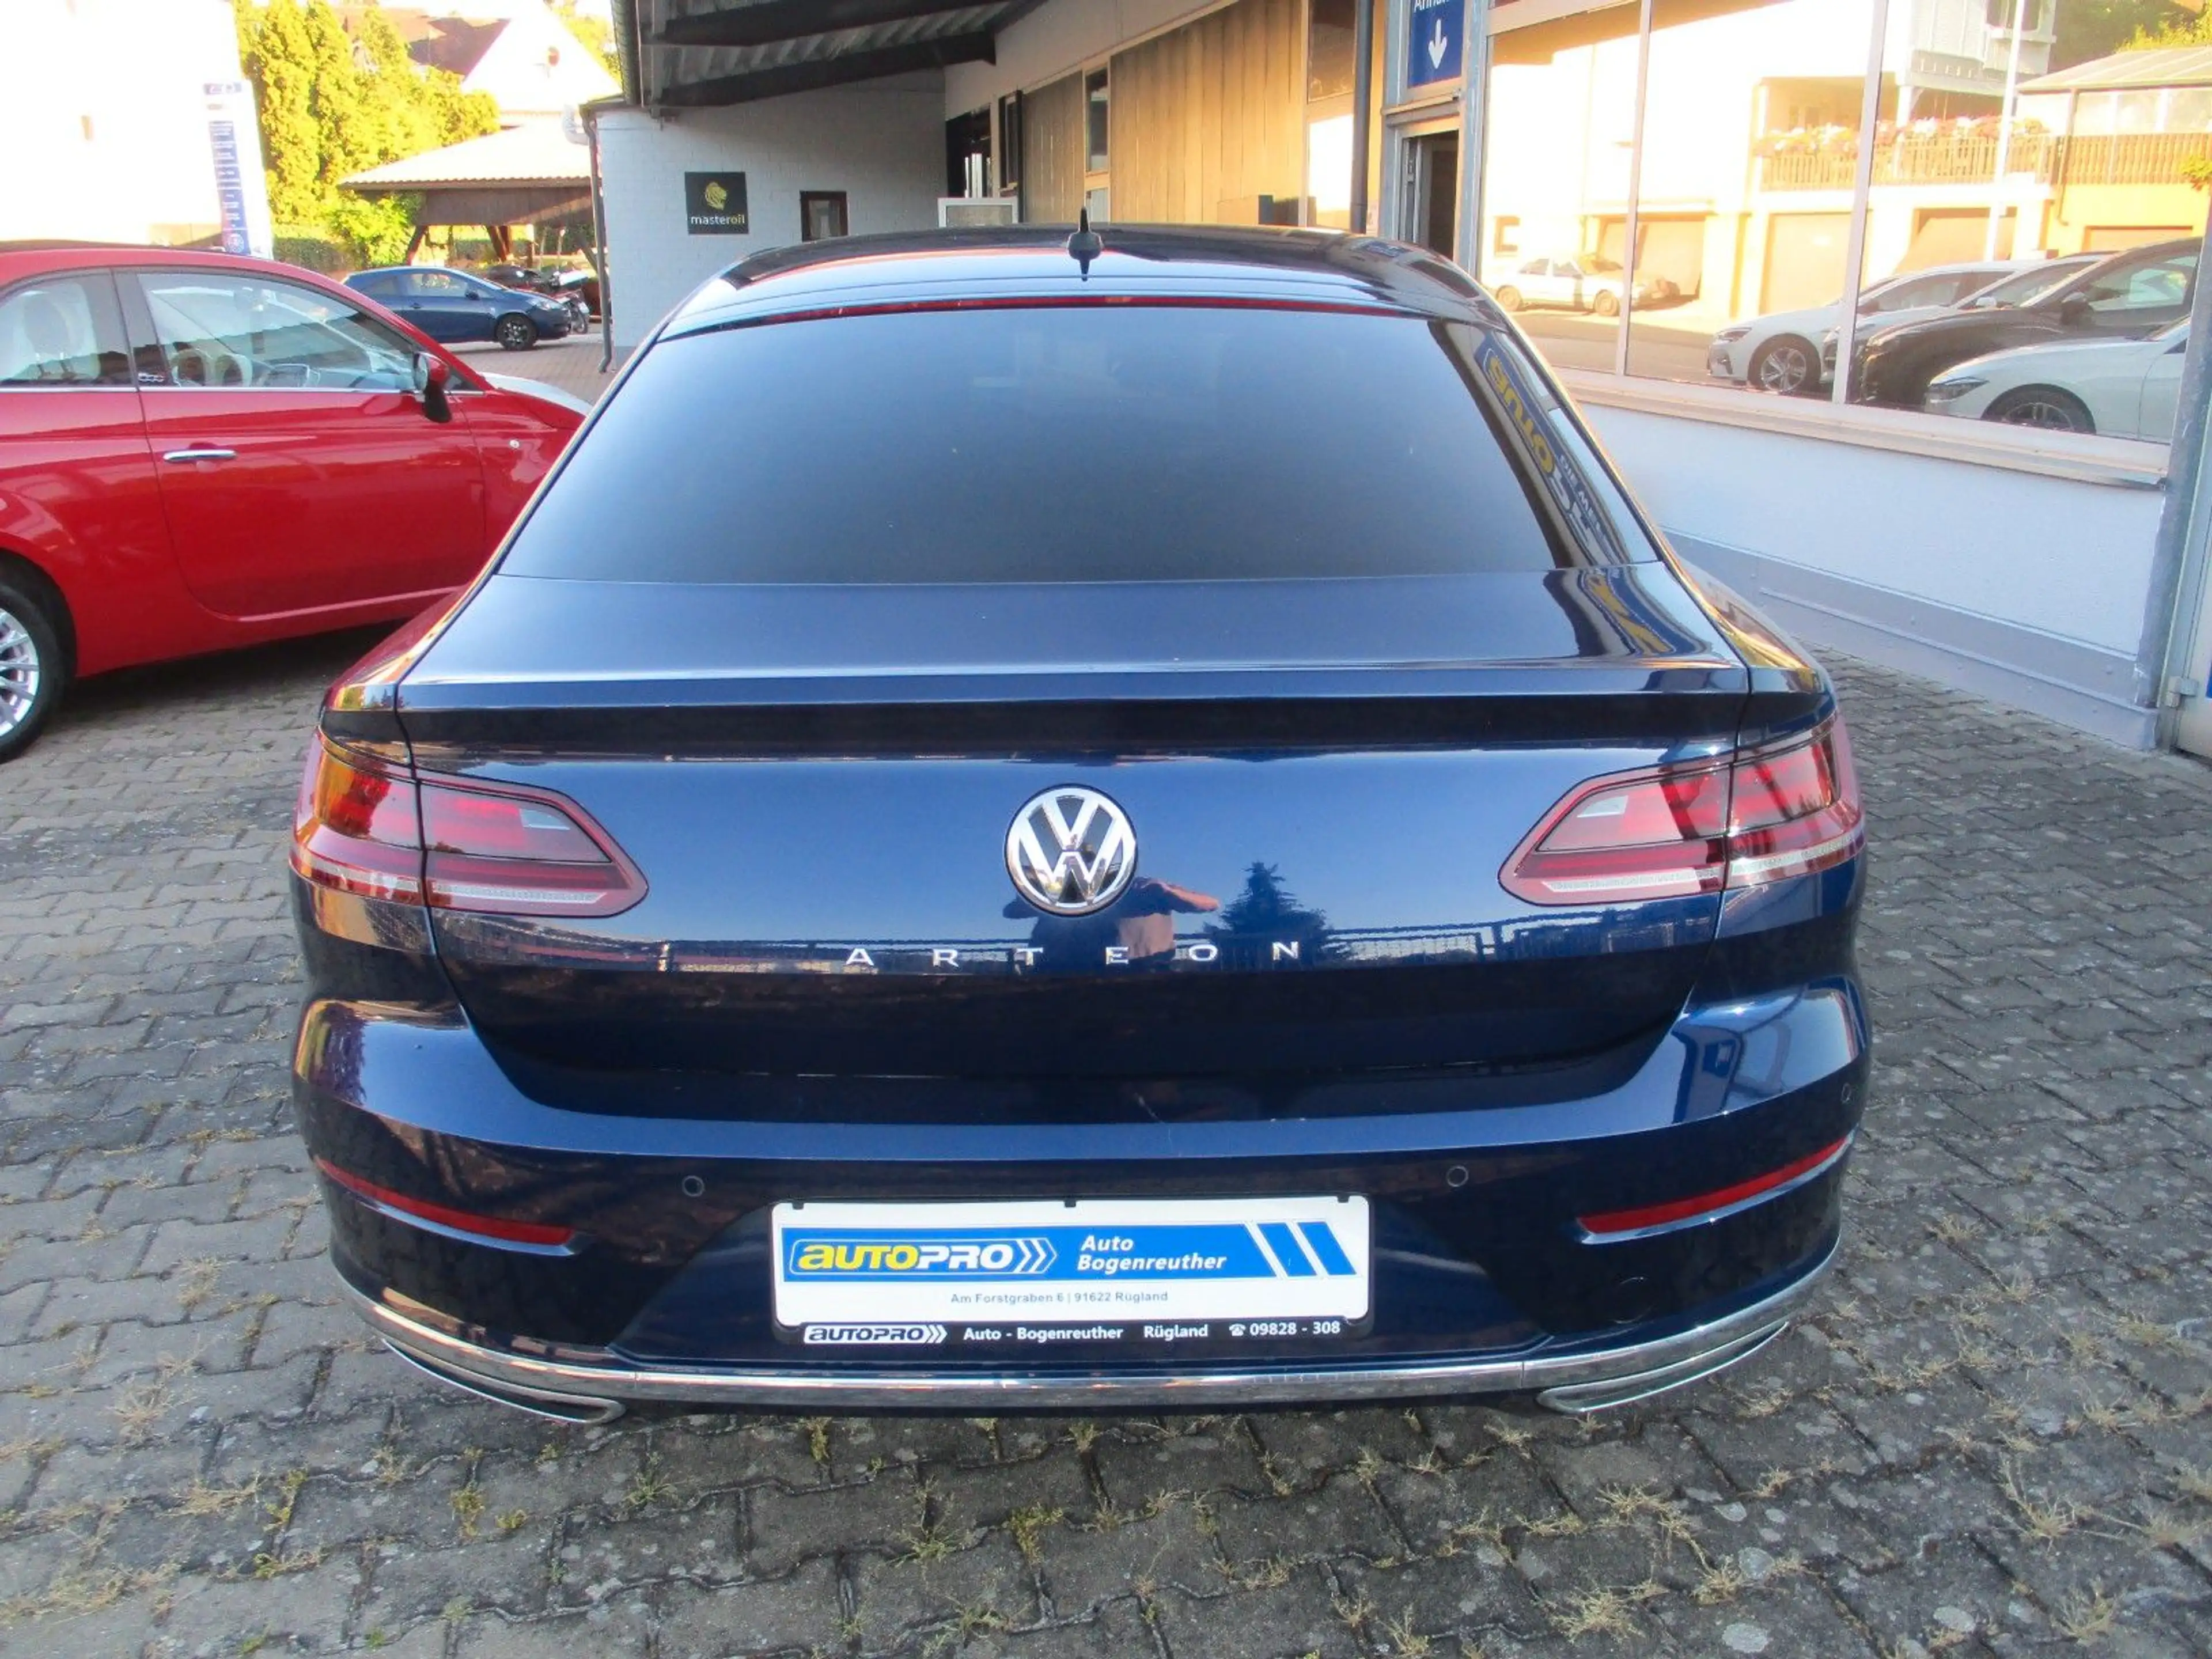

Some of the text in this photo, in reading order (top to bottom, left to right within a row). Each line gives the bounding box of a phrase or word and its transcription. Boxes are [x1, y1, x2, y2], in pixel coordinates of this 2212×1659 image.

[691, 214, 745, 225] masteroil
[1081, 1235, 1134, 1251] Auto
[1077, 1252, 1228, 1275] Bogenreuther
[950, 1293, 972, 1303] Am
[975, 1293, 1053, 1305] Forstgraben
[1074, 1292, 1112, 1302] 91622
[963, 1327, 1002, 1340] Auto
[1017, 1326, 1124, 1343] Bogenreuther
[1143, 1325, 1209, 1342] Rügland
[1249, 1323, 1297, 1336] 09828
[1312, 1321, 1341, 1334] 308
